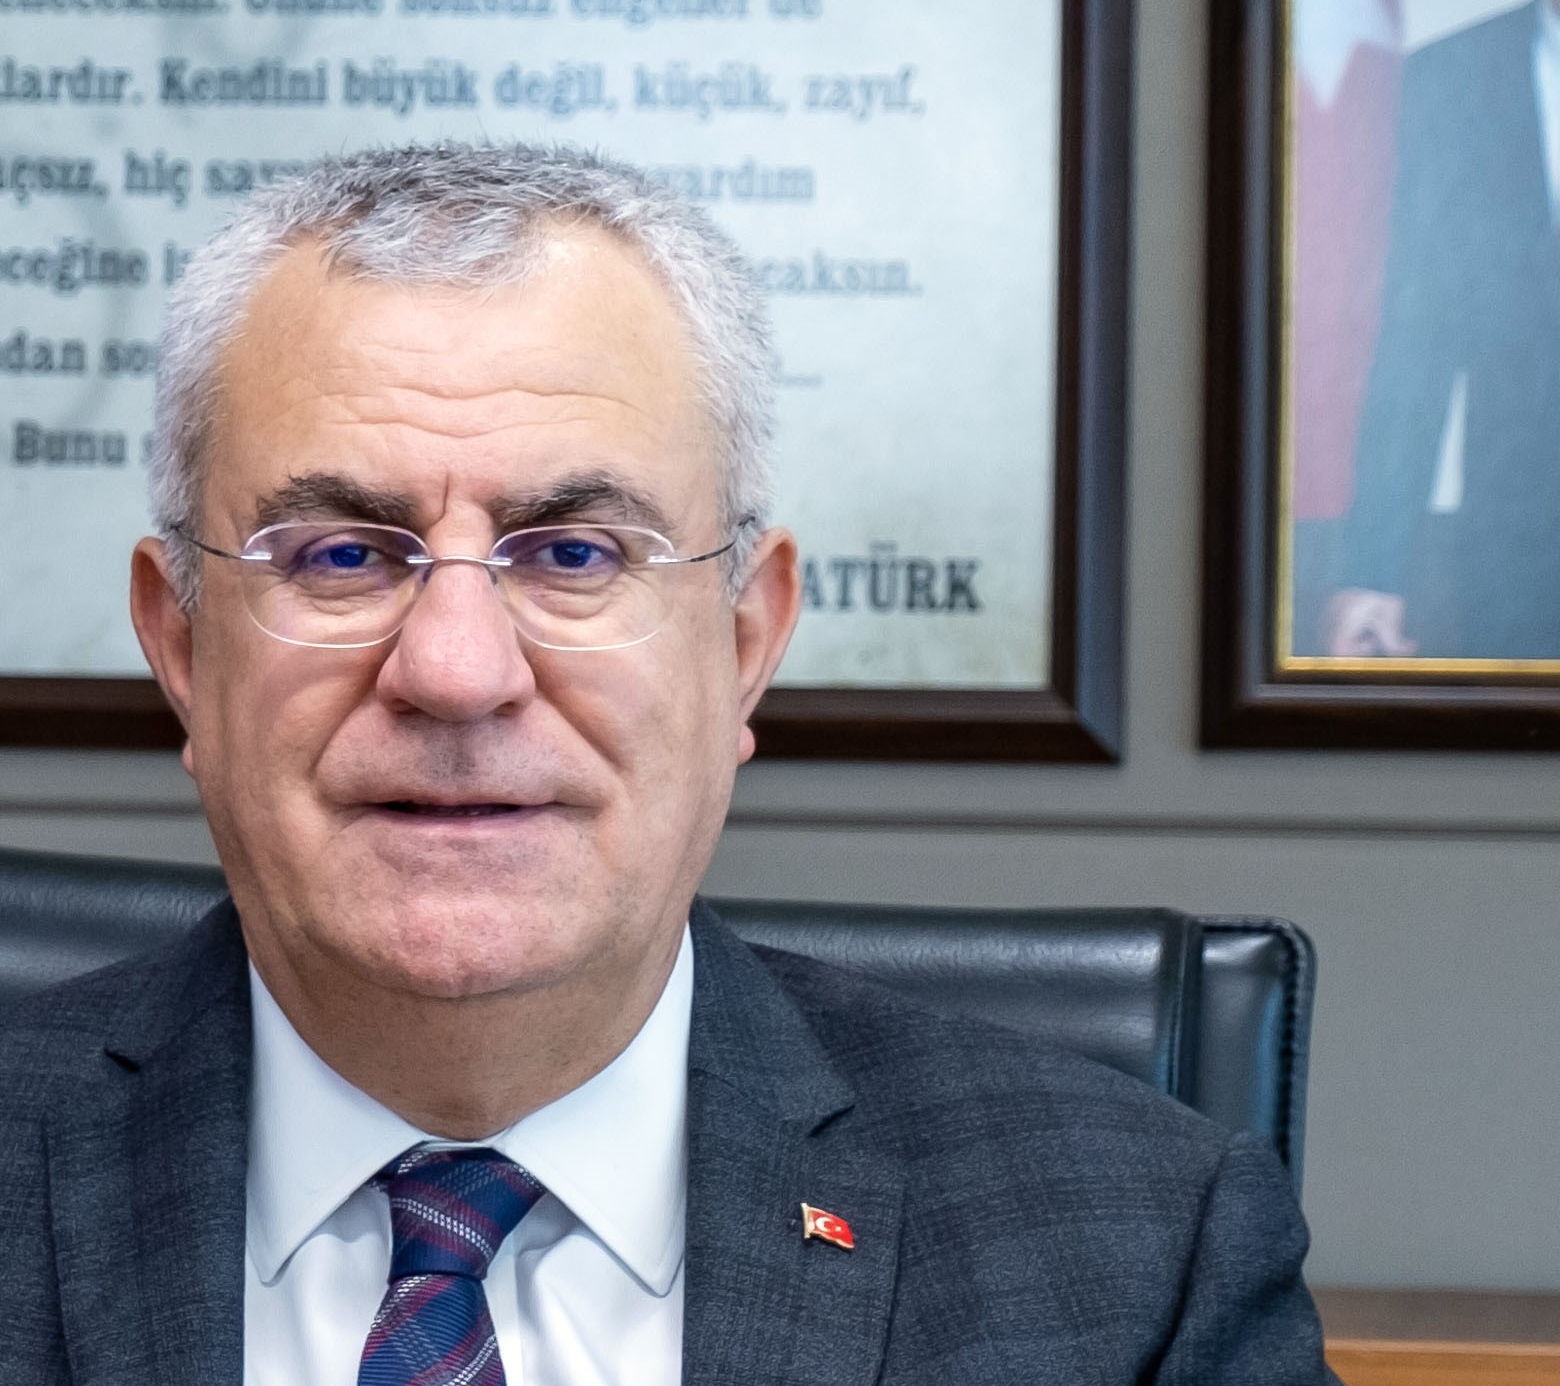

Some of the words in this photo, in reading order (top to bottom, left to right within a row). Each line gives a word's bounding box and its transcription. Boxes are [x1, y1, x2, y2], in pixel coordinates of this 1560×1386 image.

[159, 59, 328, 104] Kendini
[341, 58, 479, 115] büyük
[123, 149, 191, 207] hiç
[12, 421, 127, 467] Bunu
